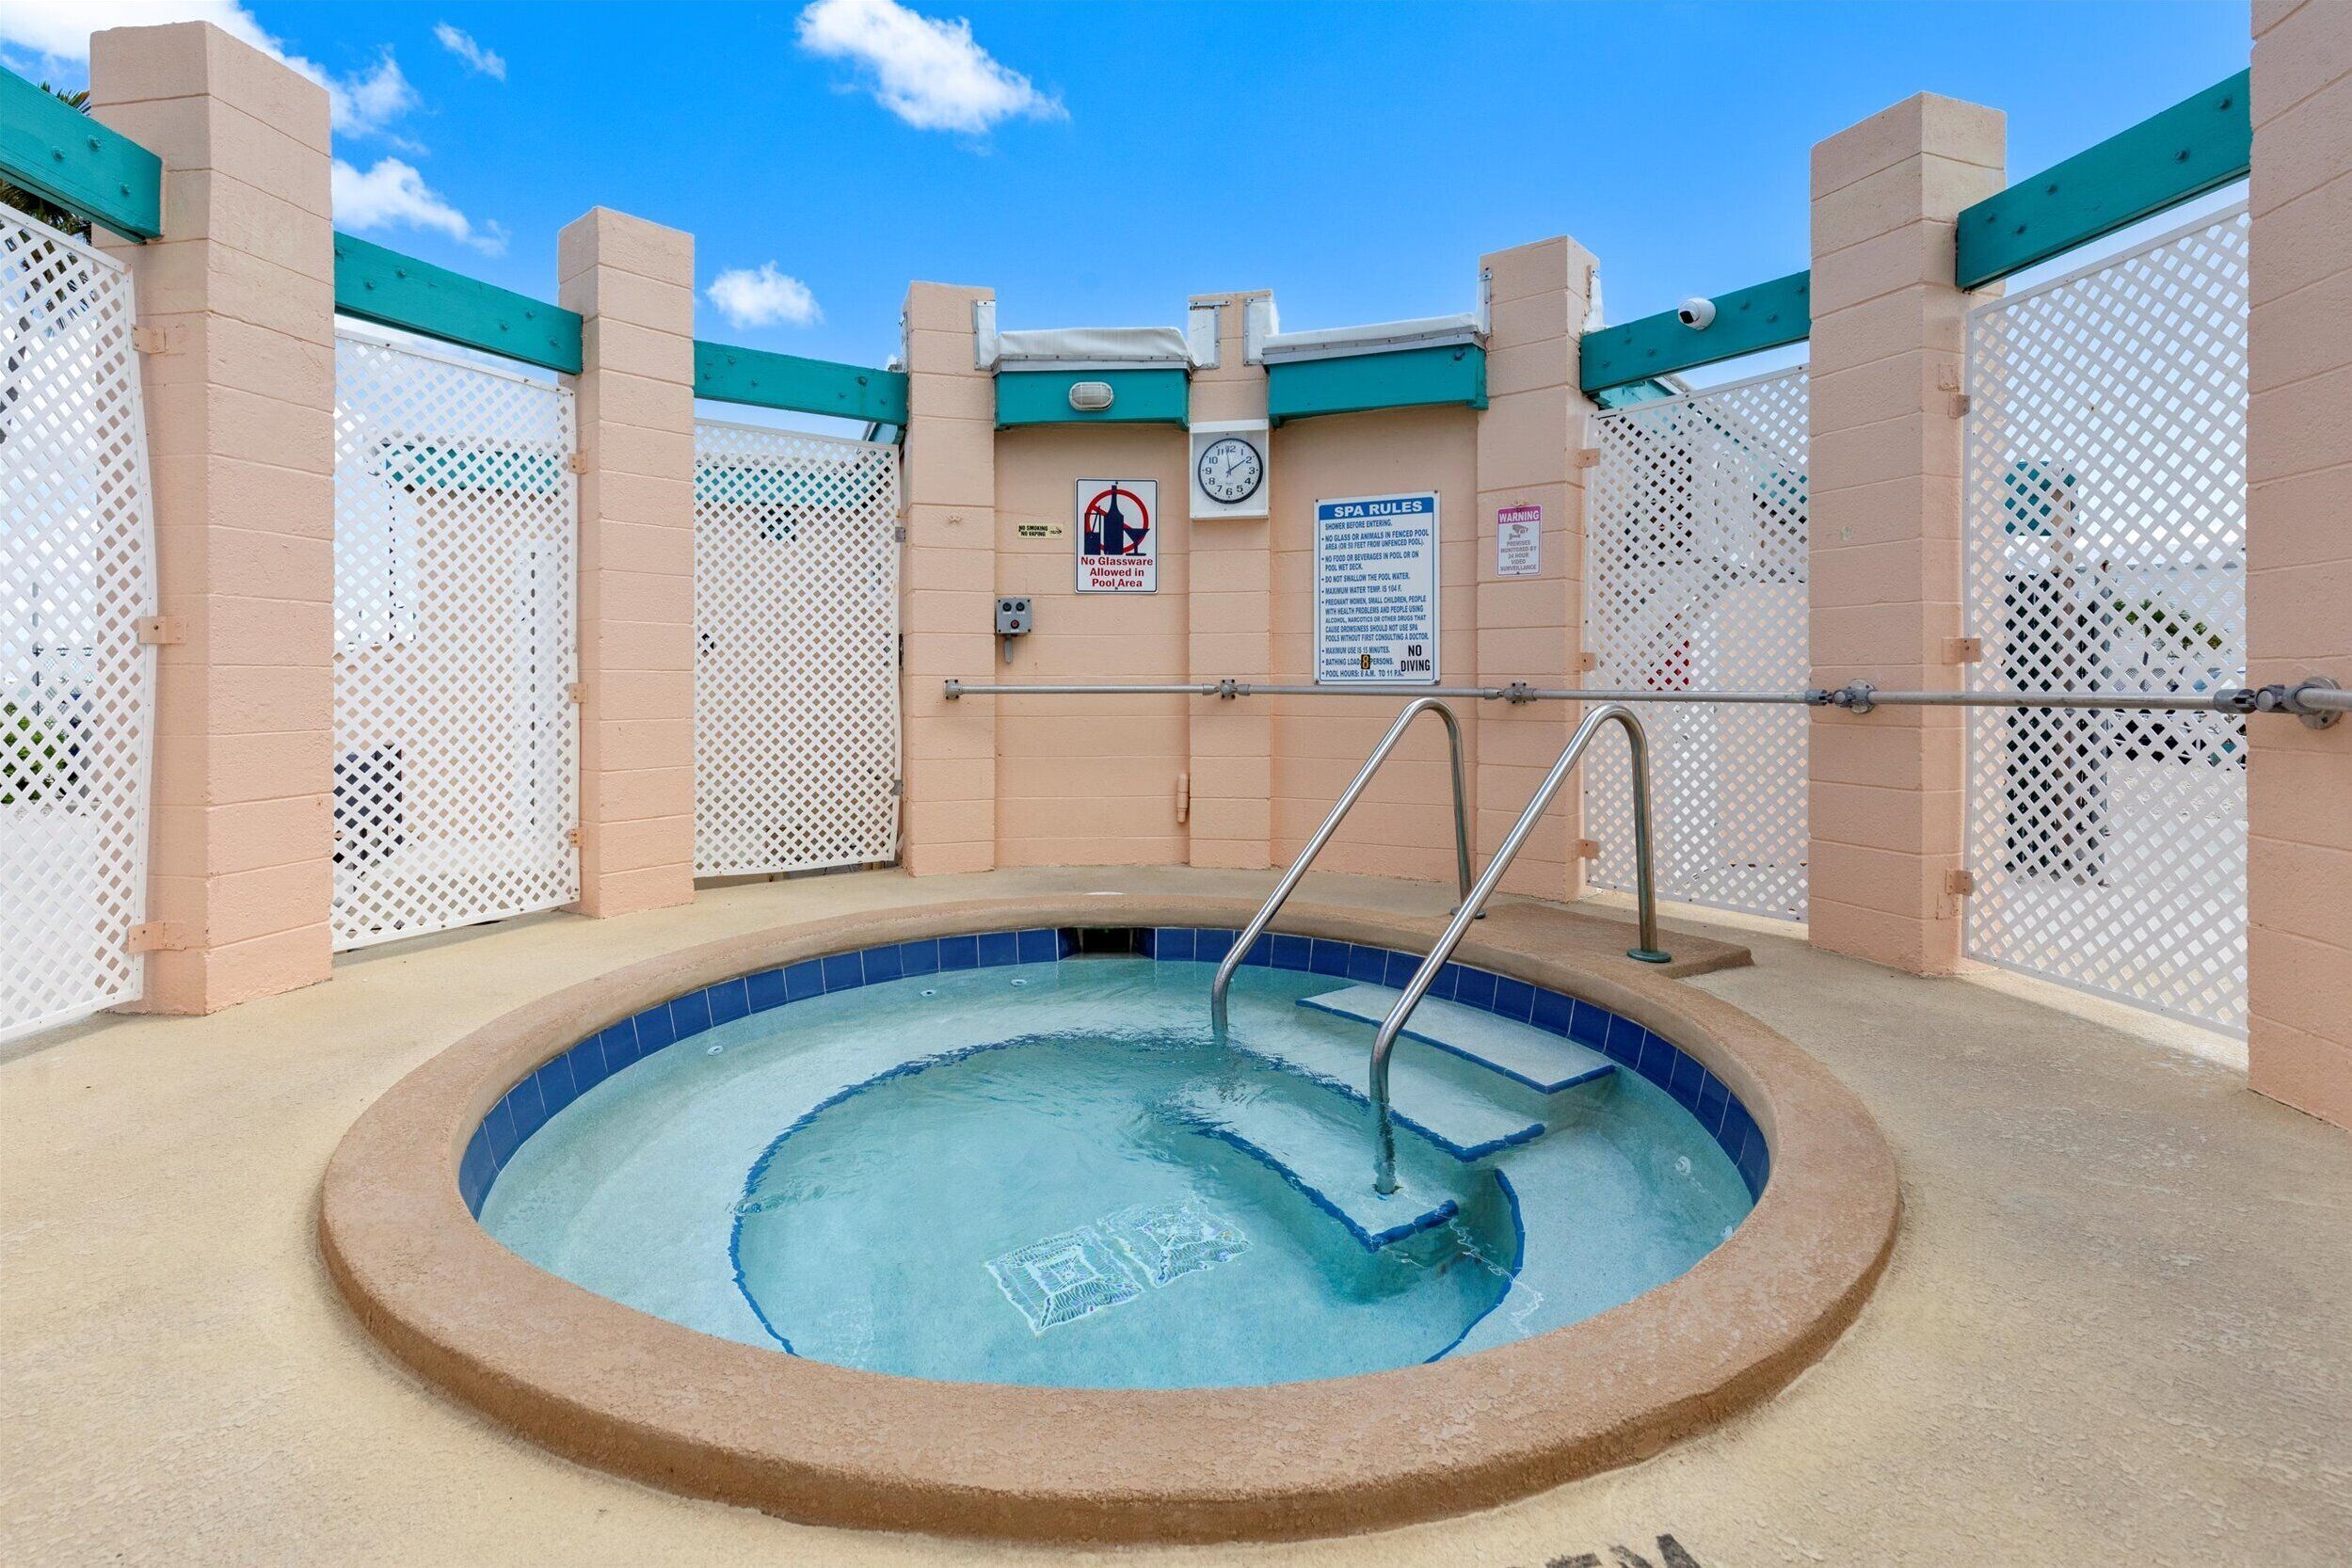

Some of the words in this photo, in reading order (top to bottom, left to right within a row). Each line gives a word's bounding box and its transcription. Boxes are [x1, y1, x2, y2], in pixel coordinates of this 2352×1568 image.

[1335, 505, 1364, 517] SPA
[1369, 501, 1422, 515] RULES
[1499, 510, 1539, 522] WARNING
[1347, 520, 1365, 529] BEFORE
[1334, 533, 1351, 541] GLASS
[1361, 531, 1384, 539] ANIMALS
[1414, 528, 1429, 536] POOL
[1354, 540, 1366, 549] FEET
[1355, 552, 1382, 561] BEVERAGES
[1408, 645, 1422, 657] NO
[1361, 655, 1370, 669] 8
[1400, 660, 1430, 672] DIVING
